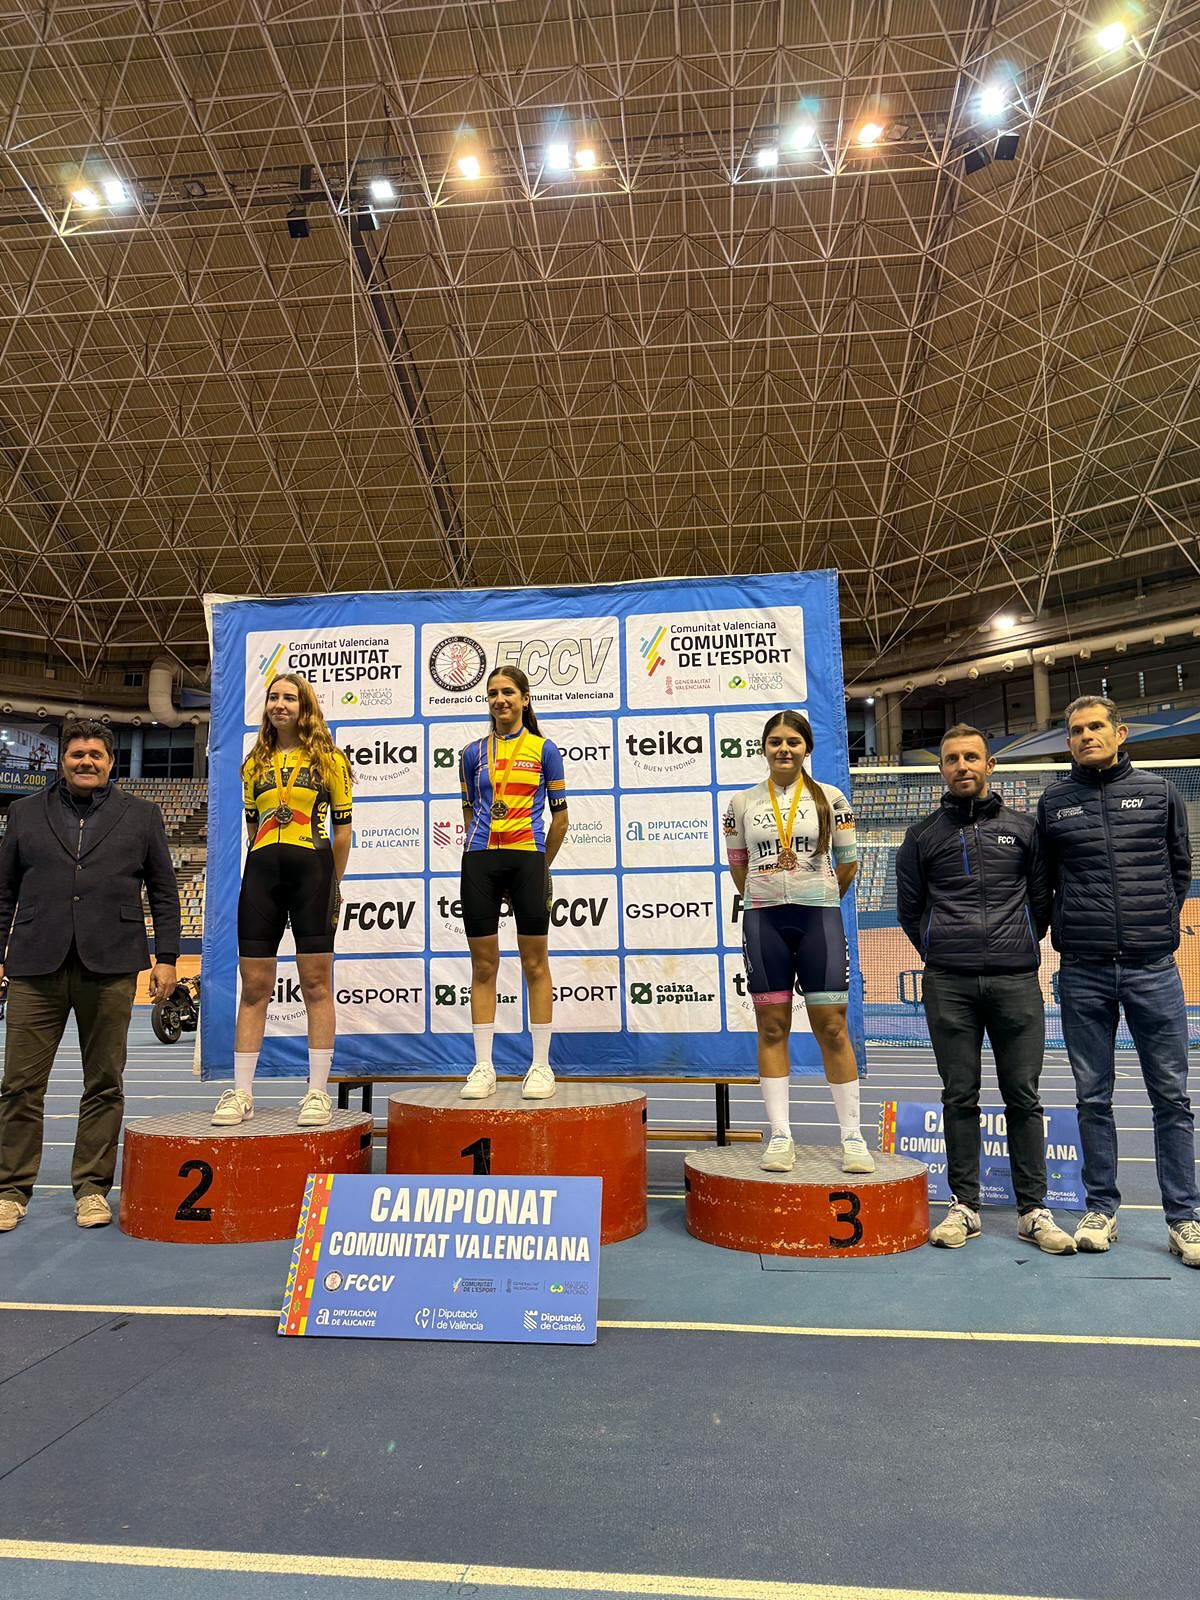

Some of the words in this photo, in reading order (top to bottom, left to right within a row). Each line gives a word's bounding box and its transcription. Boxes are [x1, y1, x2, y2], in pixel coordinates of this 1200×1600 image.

[670, 623, 721, 634] Comunitat
[723, 620, 776, 631] Valenciana
[289, 639, 337, 651] Comunitat
[339, 637, 389, 649] Valenciana
[670, 632, 777, 652] COMUNITAT
[288, 649, 389, 669] COMUNITAT
[494, 637, 614, 687] FCCV
[678, 652, 702, 668] DE
[707, 648, 792, 667] L'ESPORT
[322, 665, 403, 683] L'ESPORT
[359, 691, 393, 700] TRINIDAD
[429, 695, 472, 705] Federació
[528, 693, 563, 702] munitat
[565, 691, 614, 701] Valenciana
[625, 730, 703, 756] teika
[343, 741, 417, 766] teika
[560, 745, 611, 761] PORT
[633, 760, 641, 768] EL
[643, 764, 663, 773] BUEN
[664, 757, 697, 772] VENDING
[0, 772, 21, 784] NCIA
[23, 773, 47, 785] 2008
[359, 773, 378, 782] BUEN
[379, 766, 410, 780] VENDING
[551, 798, 567, 807] UP
[1121, 798, 1143, 809] FCCV
[648, 819, 708, 829] DIPUTACIÓN
[361, 827, 420, 837] DIPUTACIÓN
[648, 833, 660, 841] DE
[662, 831, 709, 840] ALICANTE
[361, 841, 374, 849] DE
[375, 840, 420, 848] ALICANTE
[568, 834, 612, 845] València
[997, 835, 1016, 845] FCCV
[342, 901, 416, 931] FCCV
[551, 898, 608, 927] CCV
[625, 902, 714, 919] GSPORT
[444, 922, 452, 930] EL
[551, 986, 618, 1002] SPORT
[655, 982, 694, 993] caixa
[336, 988, 423, 1005] GSPORT
[656, 991, 715, 1005] popular
[281, 1009, 308, 1020] VENDIN
[900, 1136, 948, 1154] COMUN
[460, 1137, 491, 1176] 1
[174, 1159, 215, 1222] 2
[370, 1186, 558, 1226] CAMPIONAT
[828, 1191, 864, 1249] 3
[328, 1231, 450, 1259] COMUNITAT
[454, 1234, 592, 1263] VALENCIANA
[343, 1273, 396, 1293] FCCV
[461, 1280, 493, 1288] COMUNITAT
[333, 1309, 377, 1318] DIPUTACIÓN
[438, 1308, 478, 1320] Diputació
[540, 1313, 583, 1324] Diputació
[331, 1318, 340, 1326] DE
[342, 1318, 376, 1327] ALICANTE
[436, 1320, 448, 1330] de
[450, 1320, 484, 1331] València
[540, 1322, 551, 1331] de
[552, 1321, 586, 1332] Castelló
